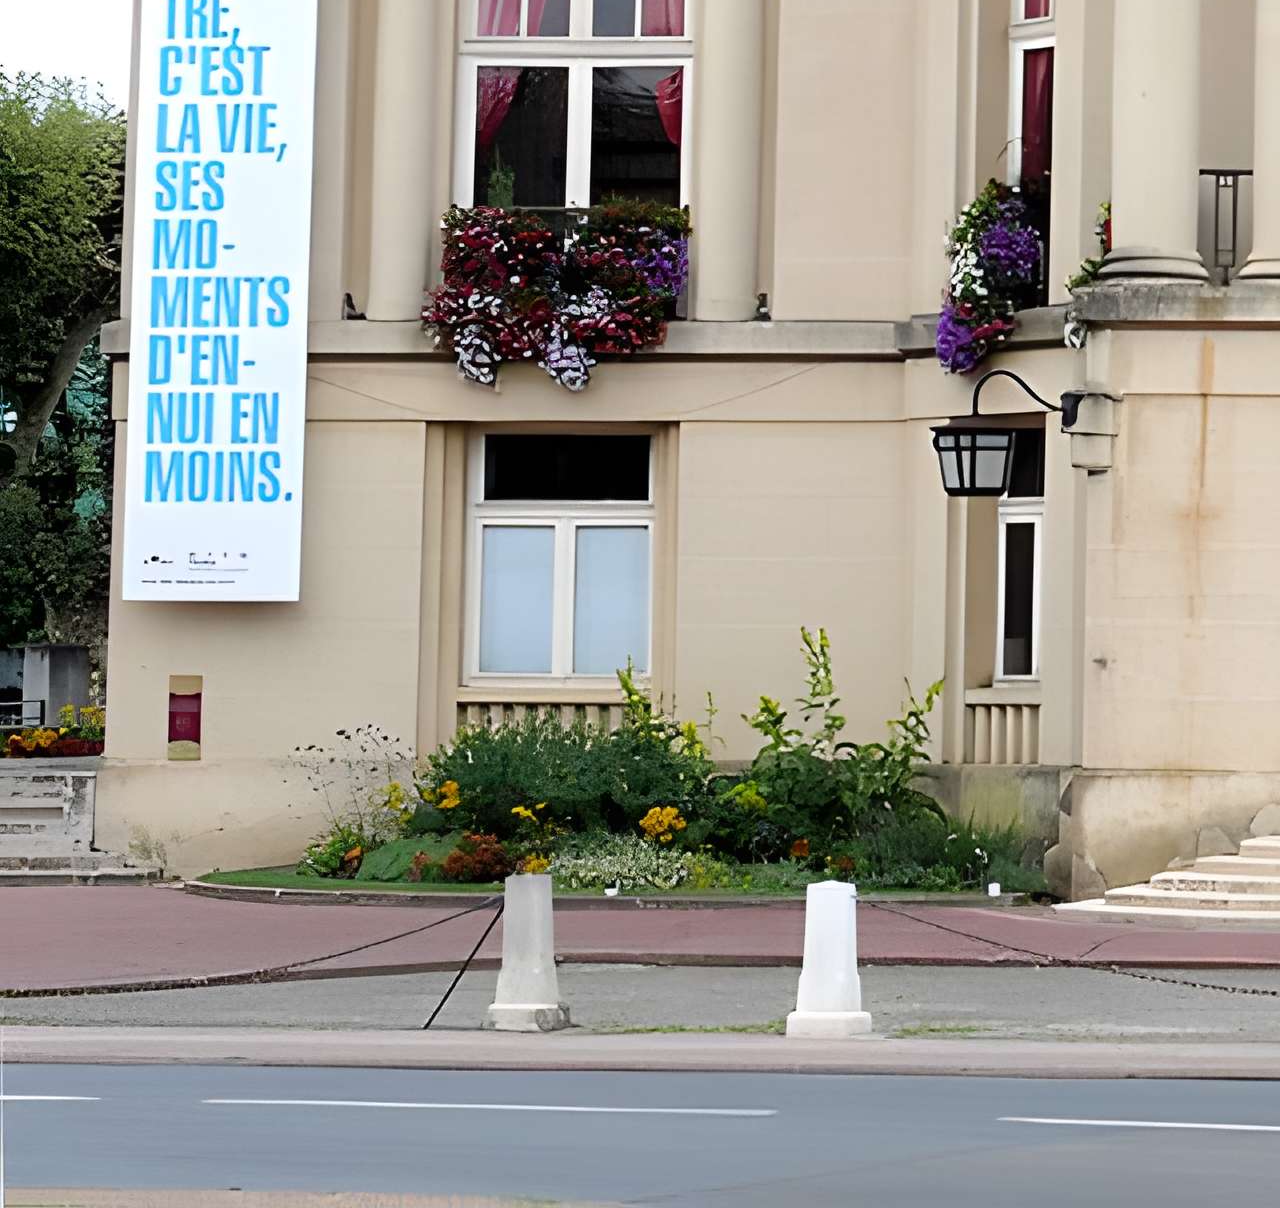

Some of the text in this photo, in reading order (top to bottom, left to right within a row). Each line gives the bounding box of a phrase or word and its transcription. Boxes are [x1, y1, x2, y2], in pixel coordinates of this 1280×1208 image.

[159, 45, 271, 97] C'EST
[156, 103, 287, 162] LA VIE,
[154, 160, 225, 212] SES
[152, 218, 235, 270] MO-
[150, 275, 290, 328] MENTS
[148, 334, 256, 386] D'EN-
[146, 392, 279, 445] NUI EN
[144, 450, 293, 504] MOINS.
